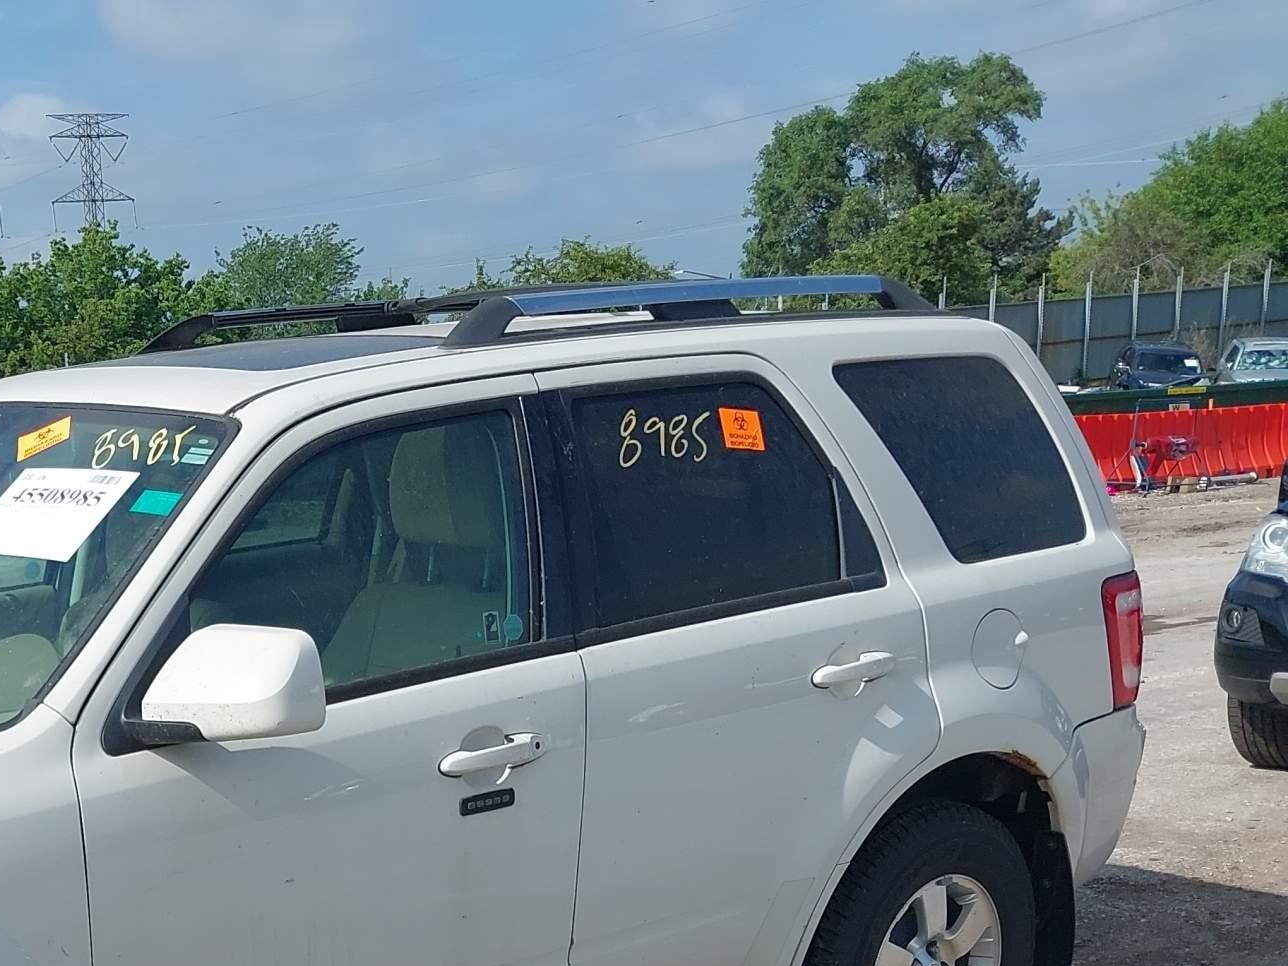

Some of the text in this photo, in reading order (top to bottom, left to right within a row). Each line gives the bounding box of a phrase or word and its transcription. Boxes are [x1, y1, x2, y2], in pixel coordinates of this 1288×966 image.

[92, 425, 197, 469] 8985
[620, 409, 710, 468] 8985
[12, 487, 107, 507] 45508985
